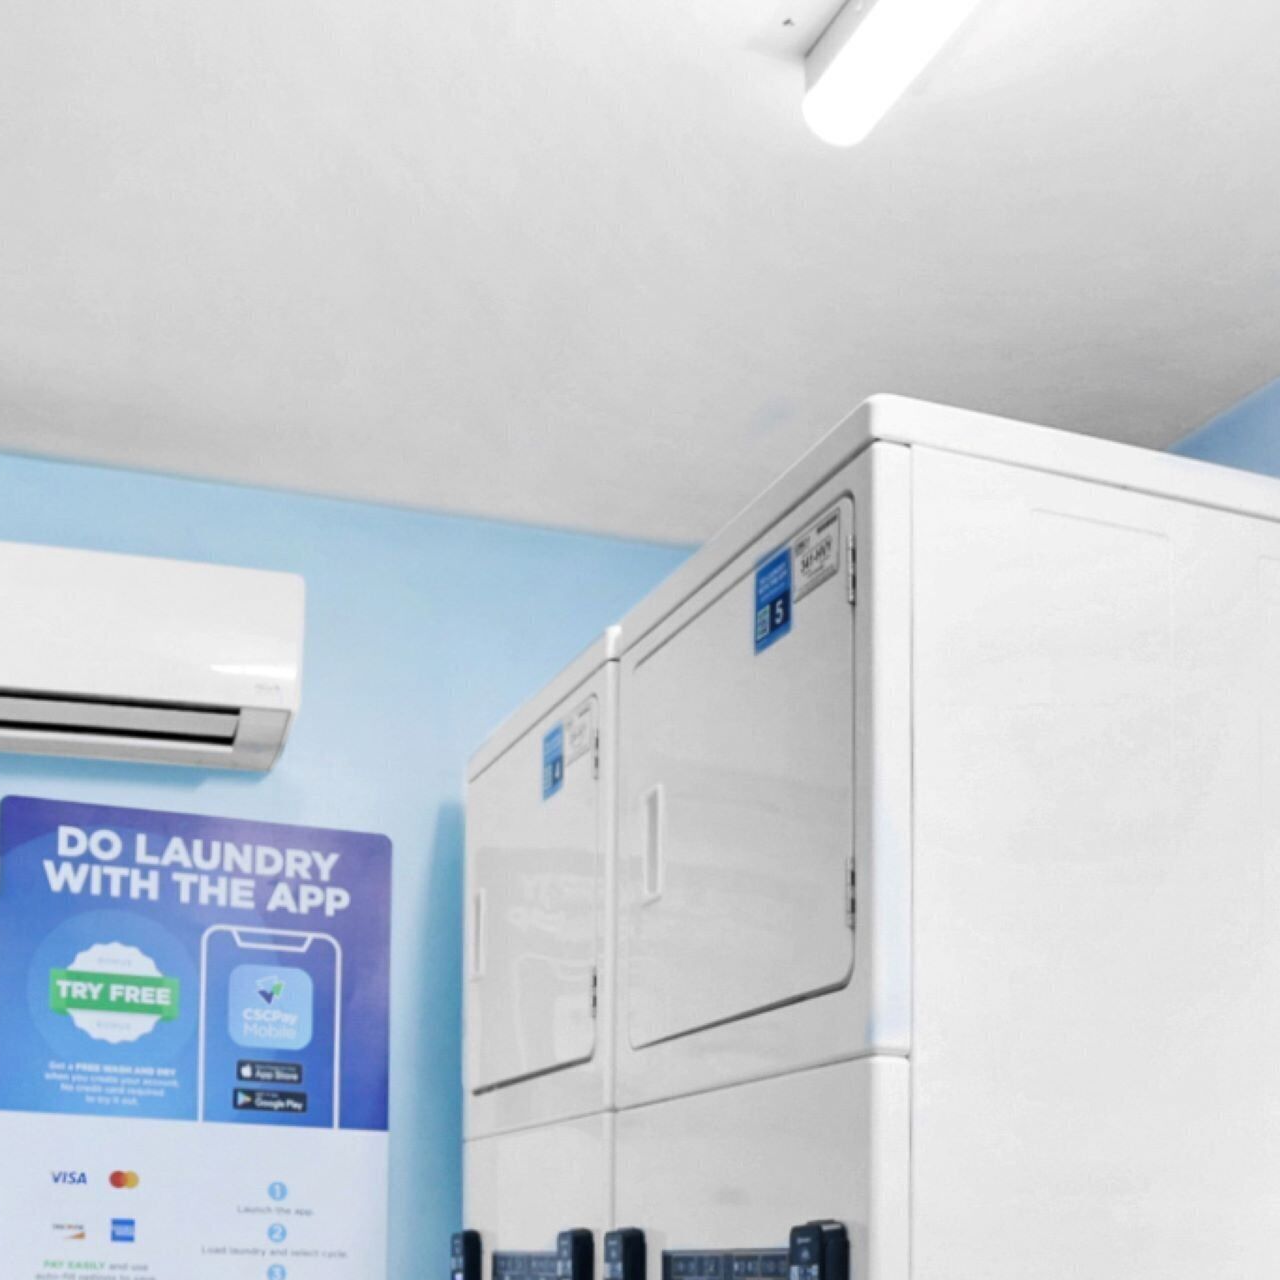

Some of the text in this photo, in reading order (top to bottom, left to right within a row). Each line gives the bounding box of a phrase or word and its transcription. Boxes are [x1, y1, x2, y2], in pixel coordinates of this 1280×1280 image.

[774, 599, 784, 624] 5
[57, 825, 339, 882] DO LAUNDRY
[43, 860, 351, 917] WITH THE APP
[56, 979, 172, 1006] TRY FREE
[242, 1022, 297, 1040] Mobile
[51, 1171, 87, 1184] VISA
